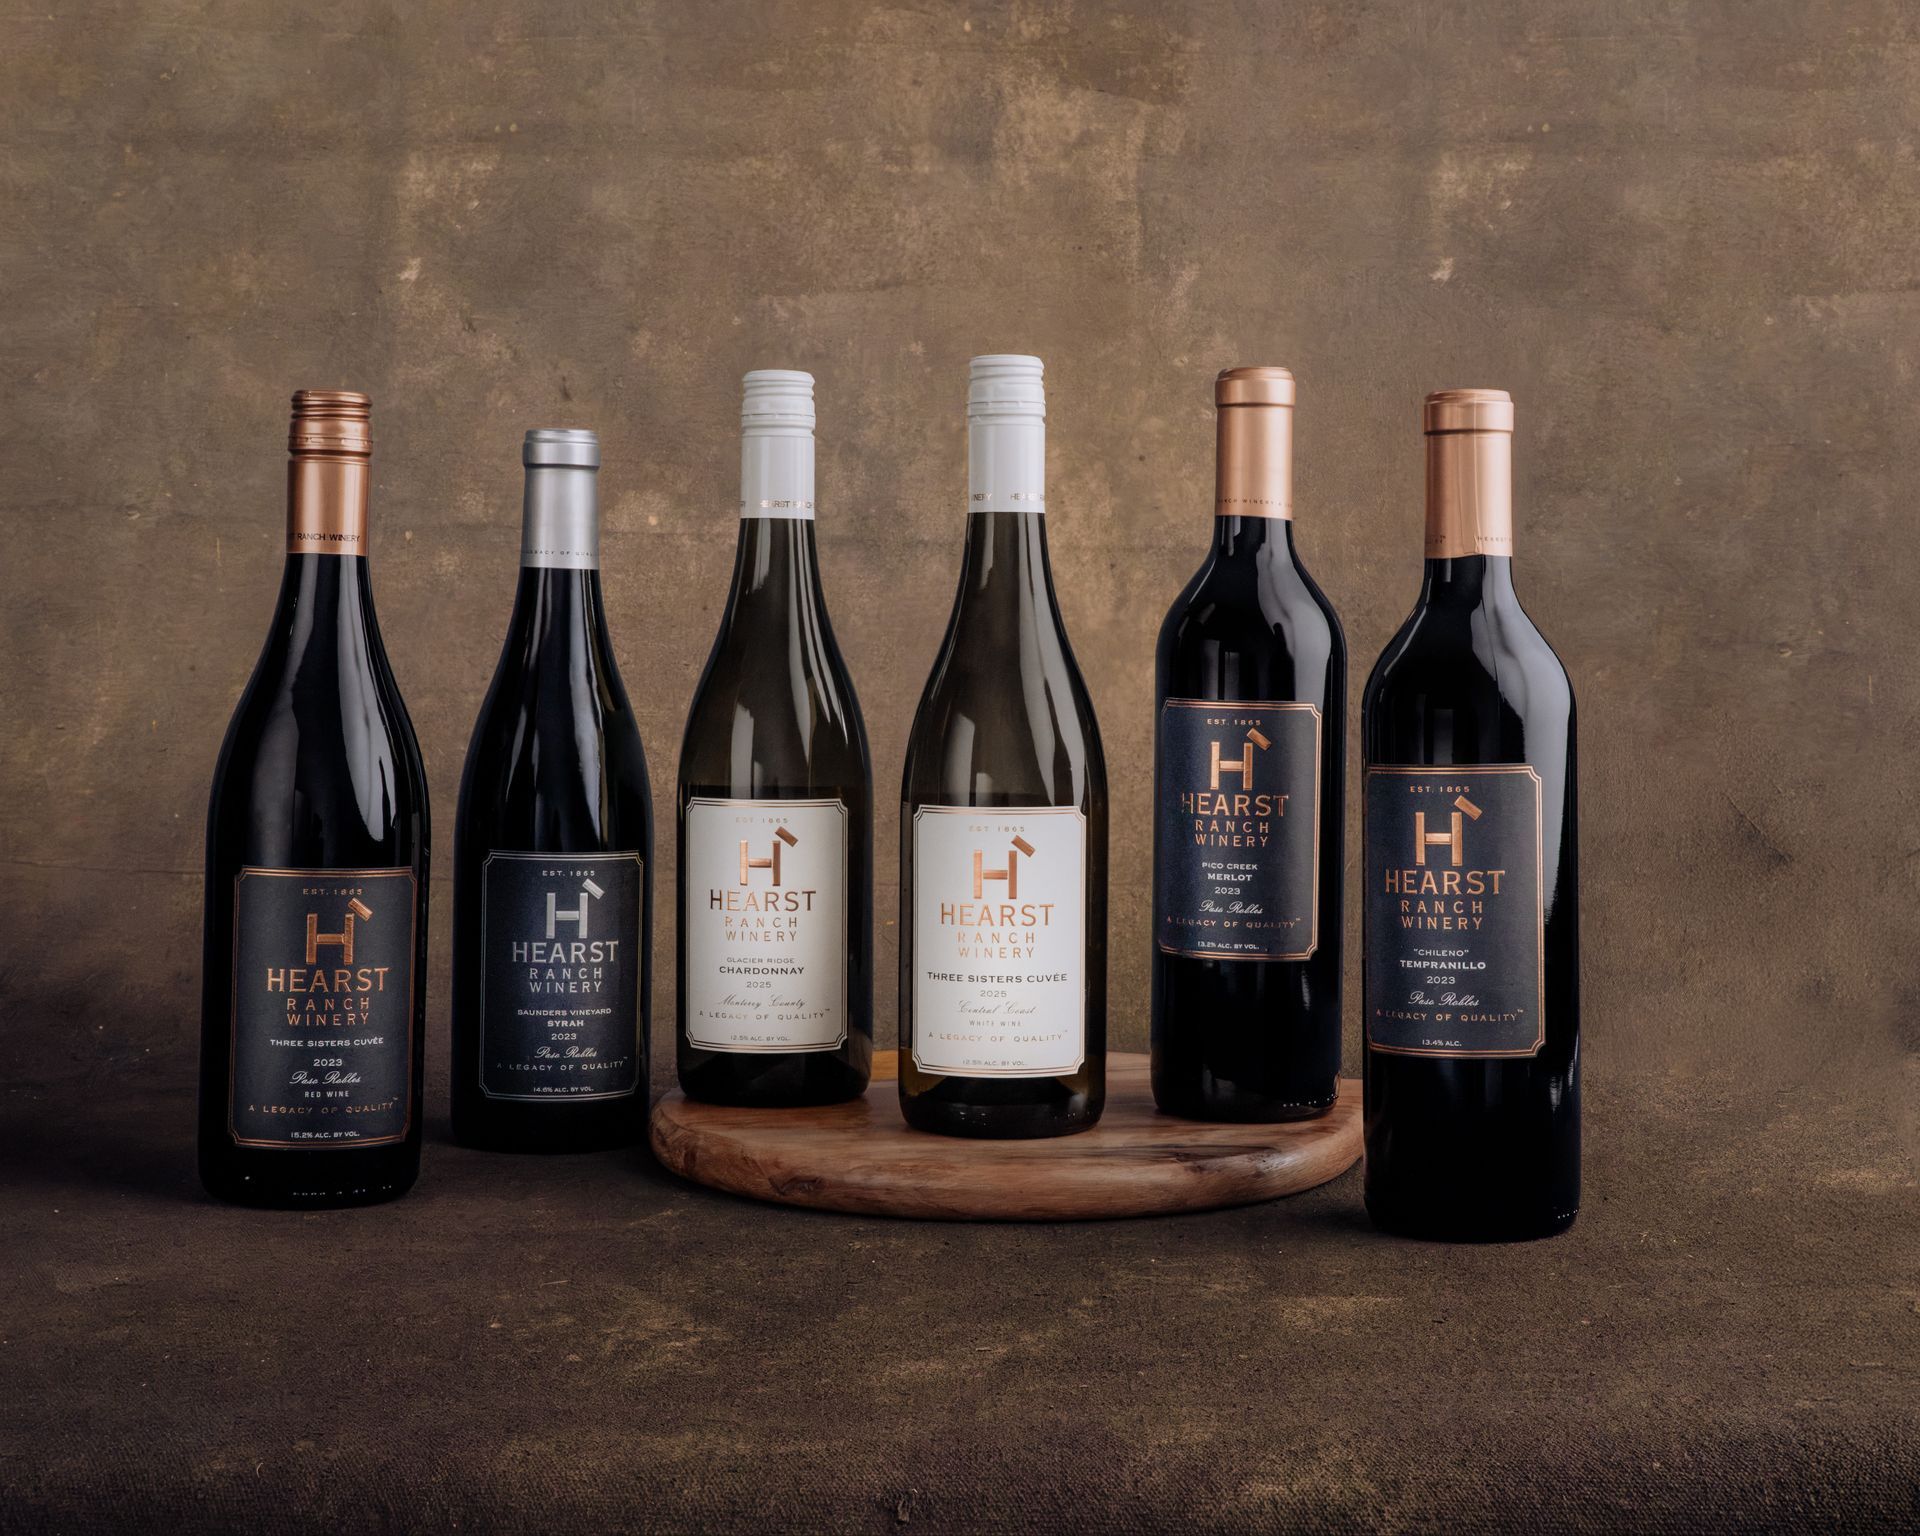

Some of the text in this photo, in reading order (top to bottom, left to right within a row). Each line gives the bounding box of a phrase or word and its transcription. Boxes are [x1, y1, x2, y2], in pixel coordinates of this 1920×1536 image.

[297, 532, 326, 542] RANCH
[329, 533, 361, 543] WINERY
[1181, 793, 1289, 817] HEARST
[1195, 820, 1269, 833] RANCH
[1195, 834, 1269, 847] WINERY
[1385, 869, 1505, 895] HEARST
[333, 888, 363, 896] 1865
[1215, 887, 1240, 895] 2023
[710, 889, 816, 912] HEARST
[1199, 900, 1264, 915] Paso Robles
[1401, 900, 1483, 914] RANCH
[940, 903, 1056, 926] HEARST
[725, 916, 797, 928] RANCH
[1224, 920, 1238, 928] OF
[1402, 916, 1483, 930] WINERY
[725, 930, 797, 942] WINERY
[958, 932, 1035, 944] RANCH
[512, 941, 619, 964] HEARST
[959, 947, 1034, 959] WINERY
[719, 966, 804, 975] CHARDONNAY
[1400, 960, 1486, 969] TEMPRANILLO
[267, 967, 389, 992] HEARST
[529, 968, 602, 979] RANCH
[928, 971, 1068, 983] THREE SISTERS CUVÉE
[1427, 976, 1455, 984] 2023
[529, 981, 602, 993] WINERY
[980, 990, 1007, 998] 2025
[1408, 991, 1480, 1007] Paso Robles
[287, 998, 370, 1011] RANCH
[958, 1000, 1037, 1014] Central Coast
[287, 1013, 370, 1026] WINERY
[709, 1011, 748, 1020] LEGACY
[1436, 1013, 1452, 1021] OF
[270, 1039, 304, 1047] THREE
[354, 1037, 384, 1046] CUVÉE
[940, 1033, 983, 1042] LEGACY
[534, 1046, 560, 1059] Paso
[313, 1058, 343, 1066] 2023
[289, 1071, 361, 1084] Paso Robles
[263, 1106, 312, 1114] LEGACY
[321, 1106, 337, 1114] OF
